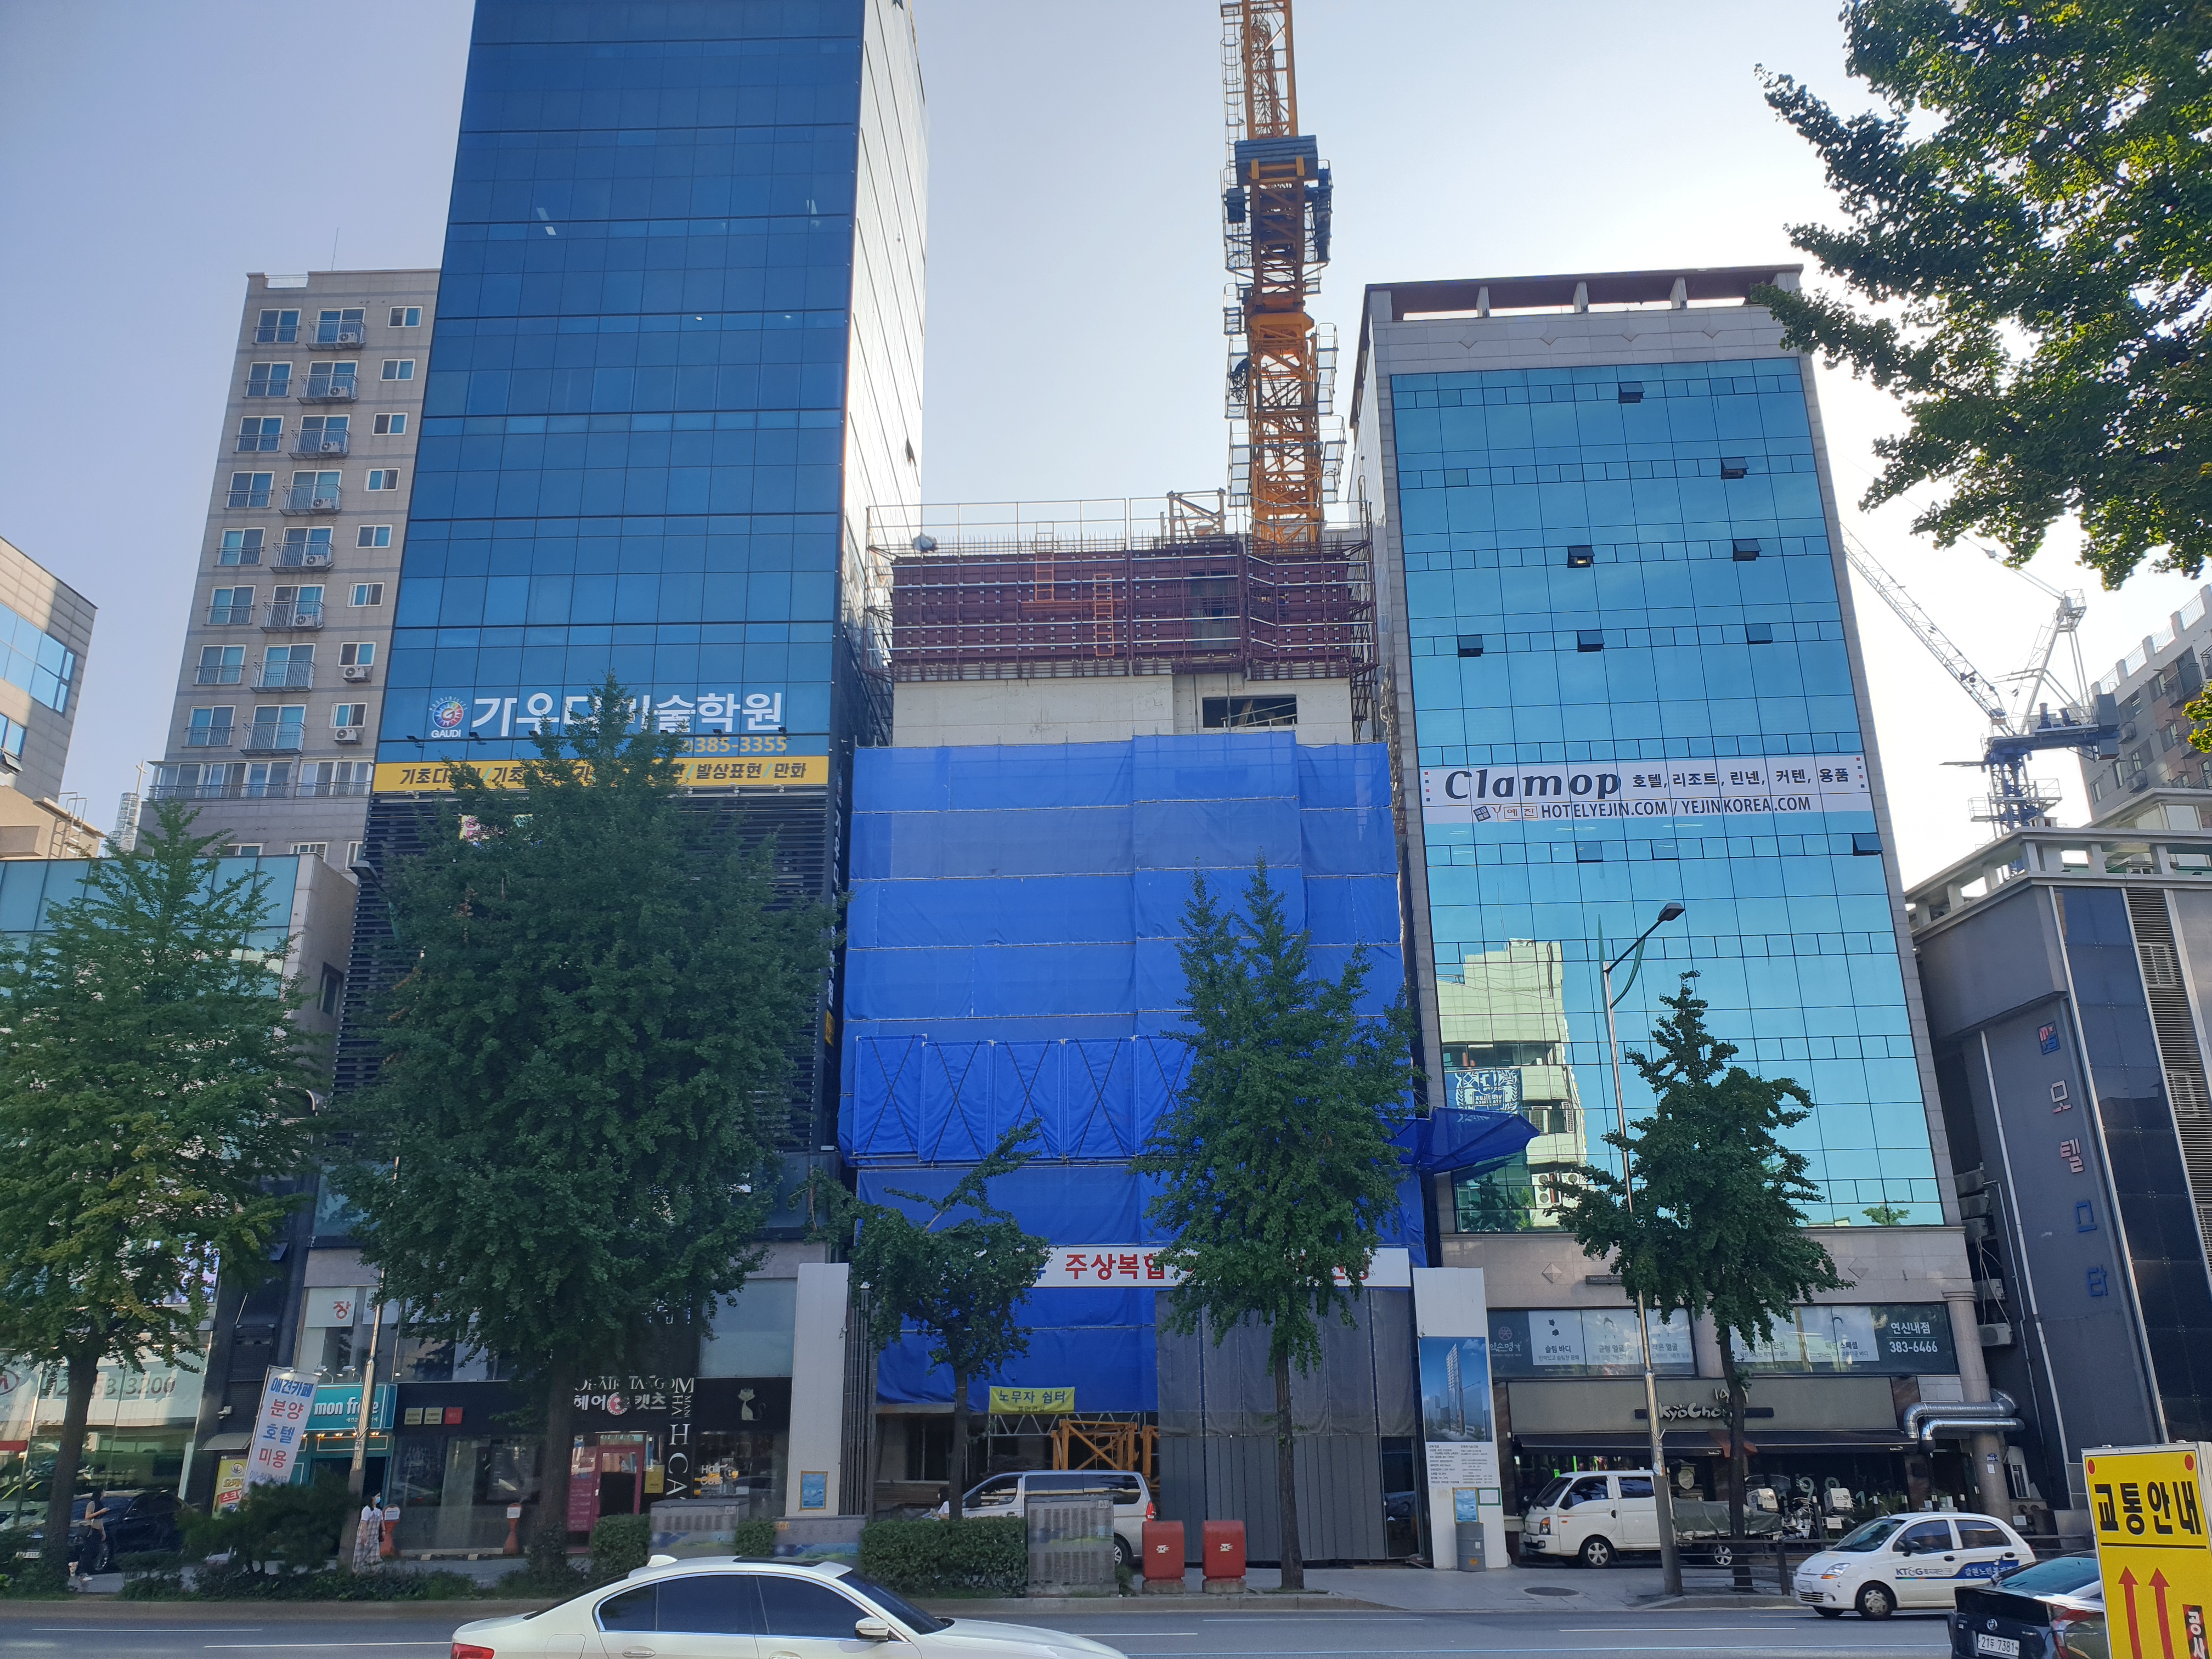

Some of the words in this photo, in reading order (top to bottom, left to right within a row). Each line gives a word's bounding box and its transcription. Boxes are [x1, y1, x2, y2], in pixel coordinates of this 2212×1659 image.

[431, 730, 461, 738] GAUDI
[697, 763, 761, 780] 발상표현
[774, 763, 806, 779] 만화
[1819, 768, 1849, 783] 용품
[1445, 769, 1622, 799] Clamop
[1541, 801, 1667, 819] HOTELYEJIN.COM
[1681, 797, 1811, 814] YEJINKOREA.COM
[2050, 1080, 2084, 1173] 모텔
[333, 1300, 352, 1319] 장
[1891, 1322, 1931, 1334] 연신내점
[1489, 1341, 1521, 1352] 약손명가
[1545, 1345, 1558, 1353] 슬림
[1559, 1345, 1571, 1353] 바디
[1773, 1341, 1786, 1350] 관리
[1889, 1340, 1938, 1353] 383-6466
[125, 1376, 176, 1395] 3200
[270, 1377, 314, 1398] 애견카페
[634, 1392, 667, 1410] 캣츠
[998, 1390, 1035, 1404] 노무자
[1042, 1390, 1065, 1404] 쉼터
[270, 1398, 304, 1421] 분양
[314, 1401, 343, 1415] mon
[263, 1423, 296, 1444] 호텔
[258, 1448, 287, 1469] 미용
[2094, 1481, 2202, 1536] 교통안내
[1895, 1567, 1923, 1576] KT&G
[1997, 1639, 2015, 1653] 7381
